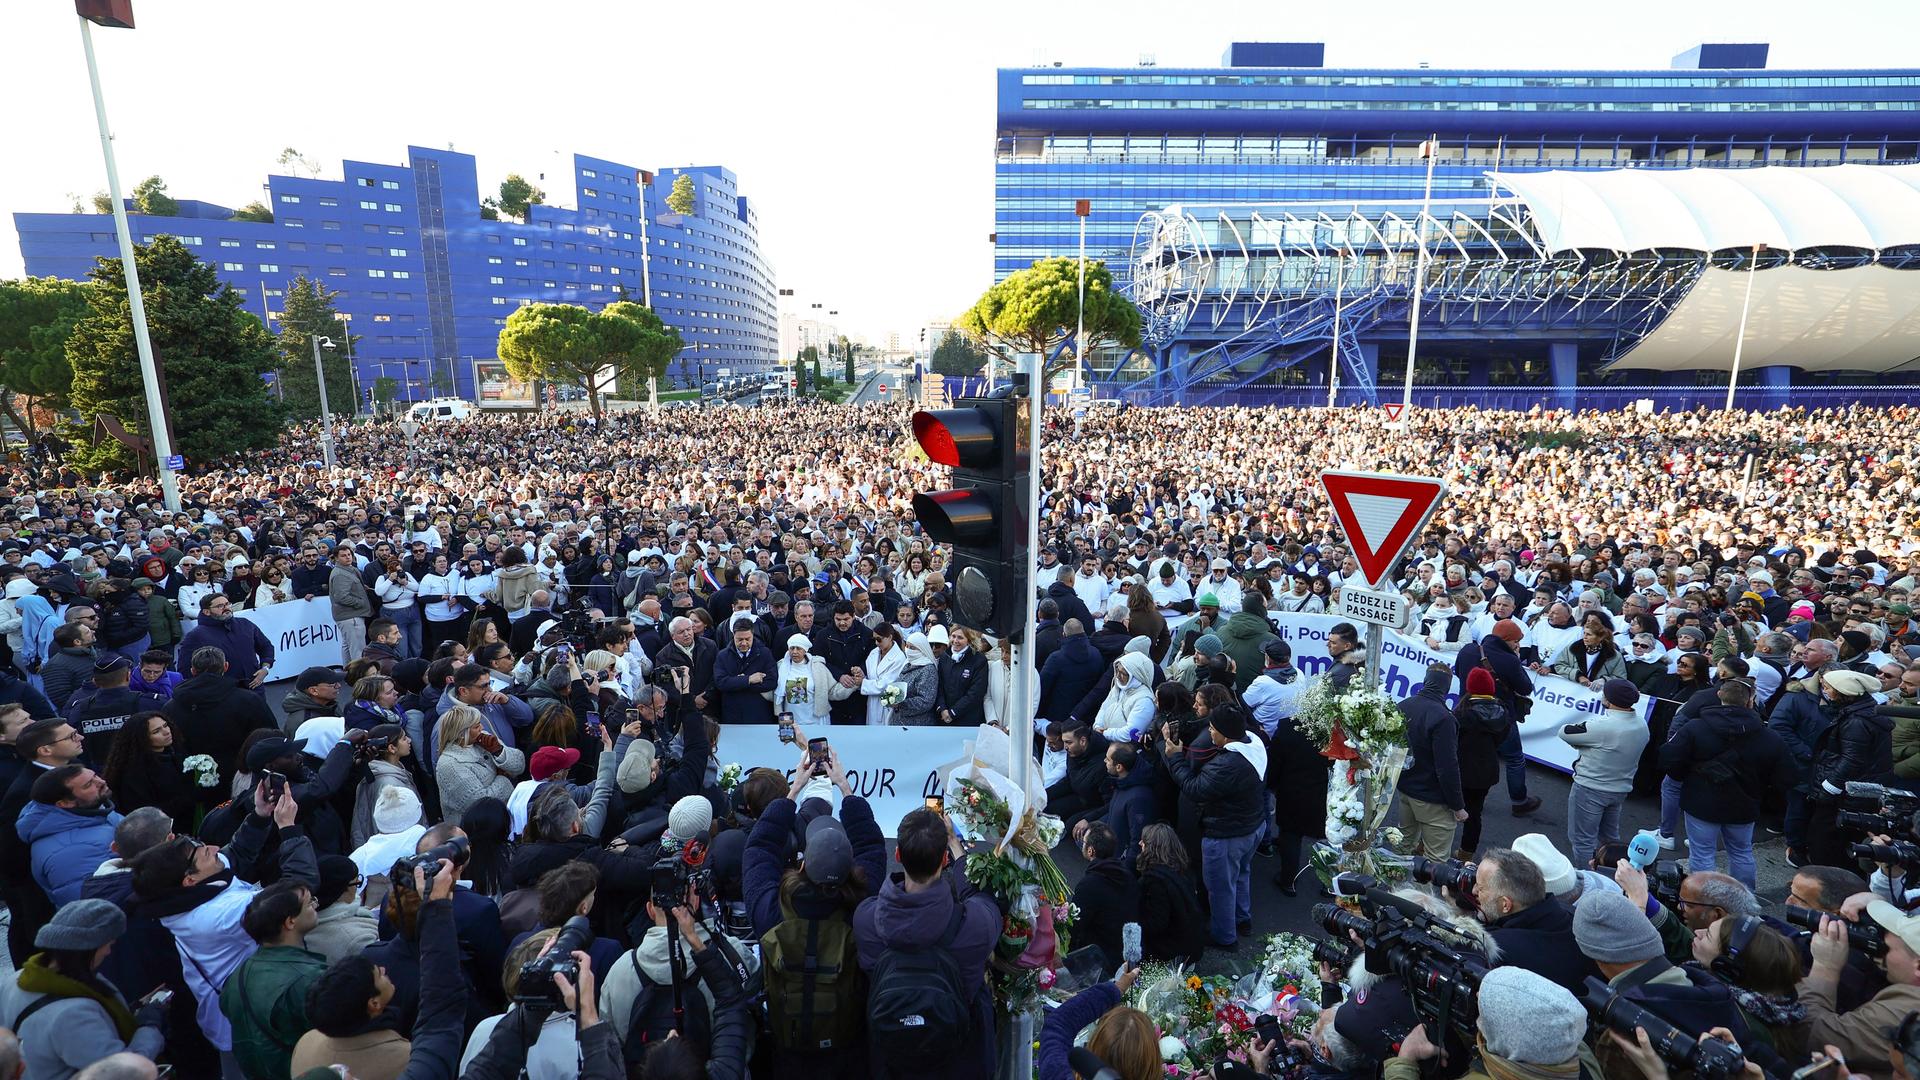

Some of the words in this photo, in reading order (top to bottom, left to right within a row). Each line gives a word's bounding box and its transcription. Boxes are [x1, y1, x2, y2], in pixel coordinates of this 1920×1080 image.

[1347, 592, 1380, 608] CÉDEZ
[1383, 600, 1396, 611] LE
[1346, 604, 1395, 623] PASSAGE
[280, 624, 339, 652] MEHDI
[1298, 627, 1331, 641] Pou
[1532, 686, 1607, 716] Marseill
[846, 768, 896, 799] OUR
